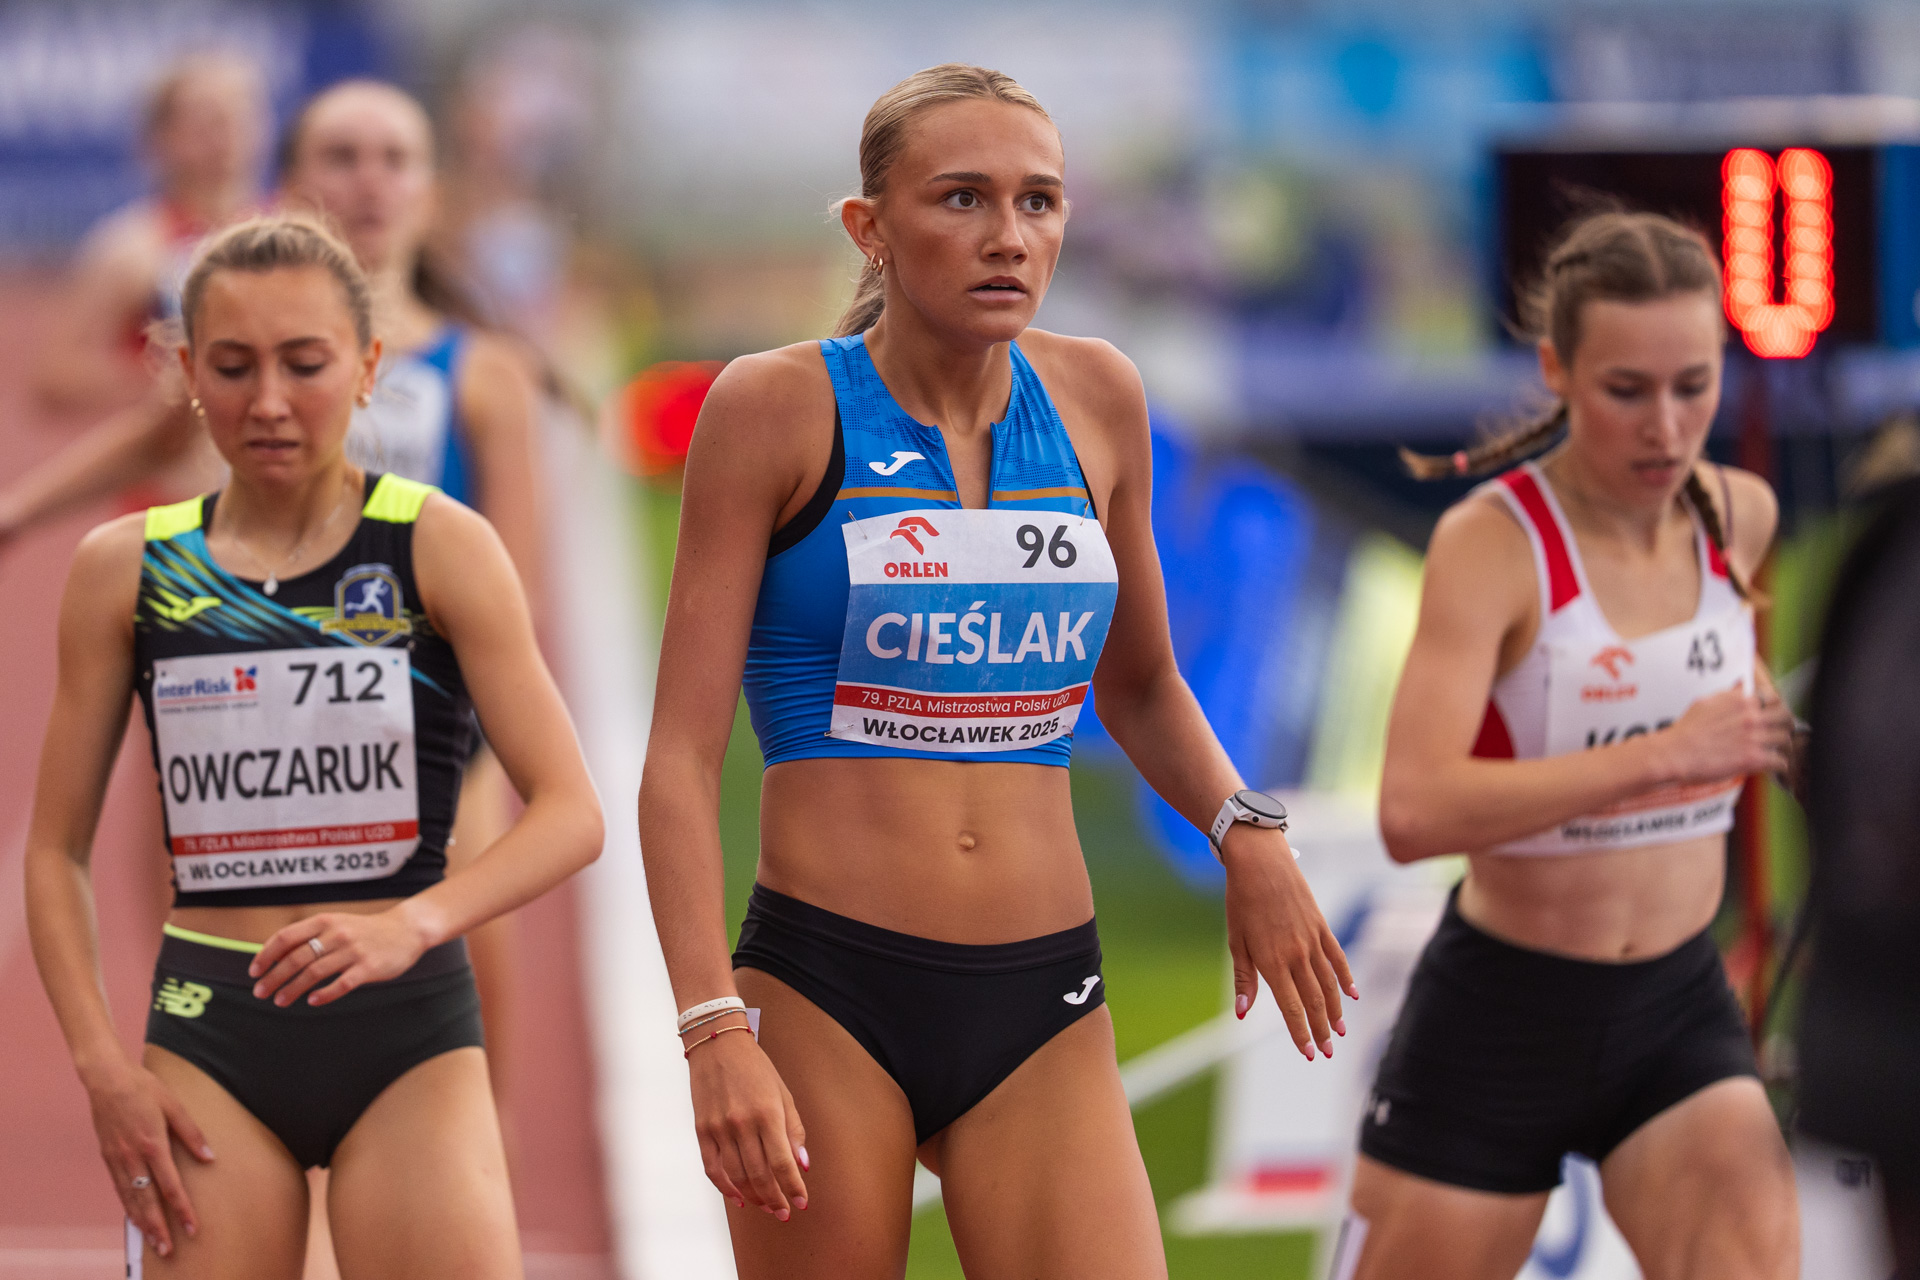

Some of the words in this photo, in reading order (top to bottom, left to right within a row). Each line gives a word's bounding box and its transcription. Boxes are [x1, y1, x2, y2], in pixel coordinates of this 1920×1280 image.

[1015, 524, 1077, 568] 96
[883, 561, 949, 578] ORLEN
[865, 600, 1095, 665] CIEŚLAK
[1686, 630, 1724, 672] 43
[288, 660, 386, 706] 712
[861, 690, 883, 706] 79.
[888, 694, 923, 711] PZLA
[927, 699, 1011, 714] Mistrzostwa
[1014, 697, 1050, 713] Polski
[1052, 692, 1070, 708] U20
[862, 717, 1017, 744] WŁOCŁAWEK
[1019, 716, 1061, 741] 2025
[168, 740, 403, 805] OWCZARUK
[188, 855, 327, 880] WŁOCŁAWEK
[334, 849, 390, 872] 2025
